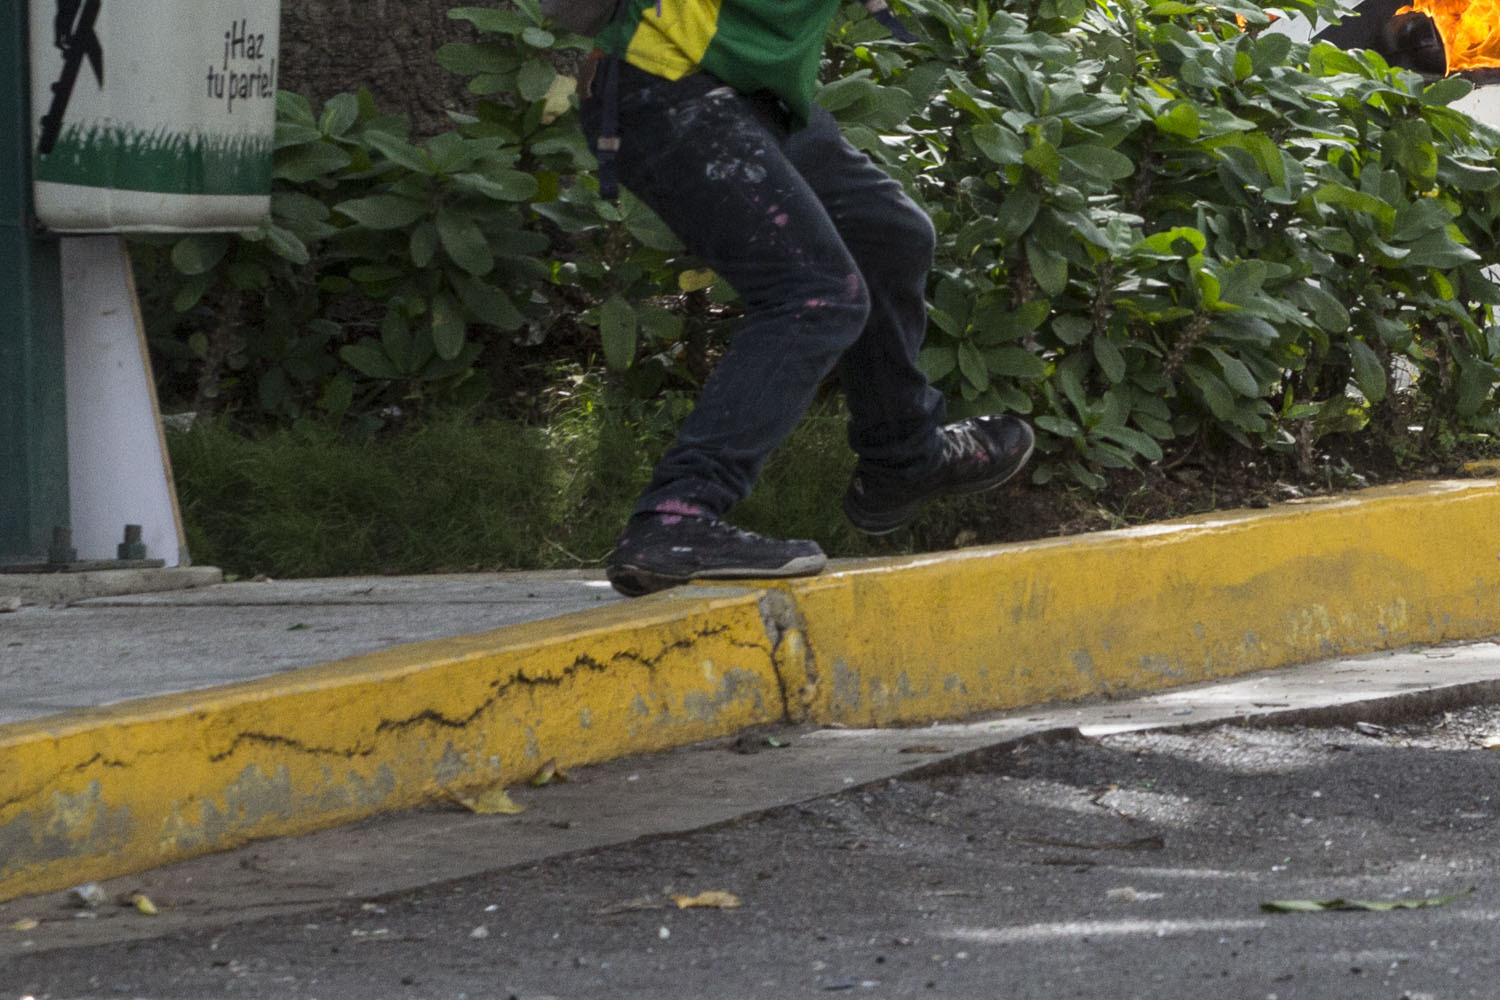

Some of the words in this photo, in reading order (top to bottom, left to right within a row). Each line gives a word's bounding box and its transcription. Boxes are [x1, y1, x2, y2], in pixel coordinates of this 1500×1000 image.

[224, 18, 264, 71] ¡Haz
[207, 65, 224, 99] tu
[227, 58, 275, 113] parte!
